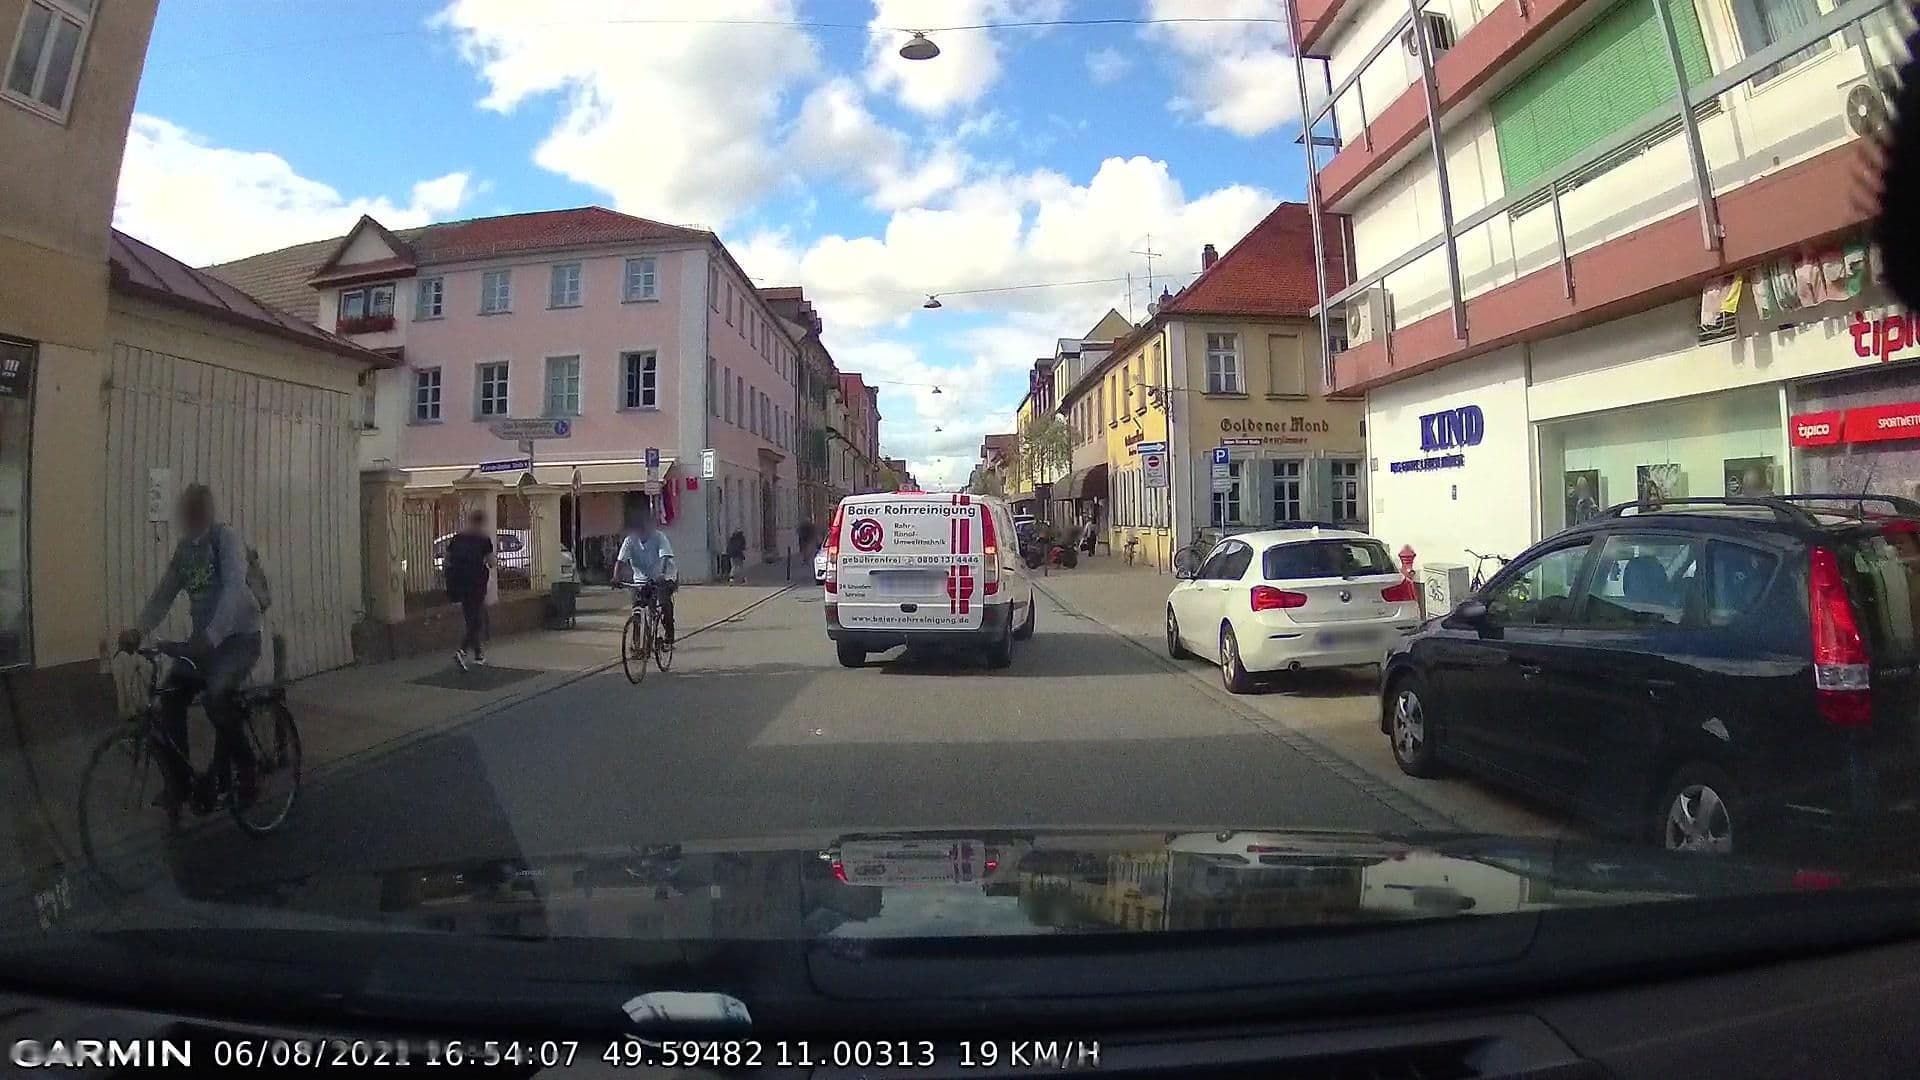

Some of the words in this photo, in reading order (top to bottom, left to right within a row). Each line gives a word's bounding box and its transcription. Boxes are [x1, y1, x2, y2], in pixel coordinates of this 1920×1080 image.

[1220, 417, 1287, 432] Goldener
[1290, 415, 1329, 433] Mond
[1419, 404, 1484, 451] KIND
[1798, 422, 1830, 439] tipico
[848, 505, 880, 515] Baier
[884, 504, 976, 517] Rohrreinigung
[917, 556, 939, 564] 0800
